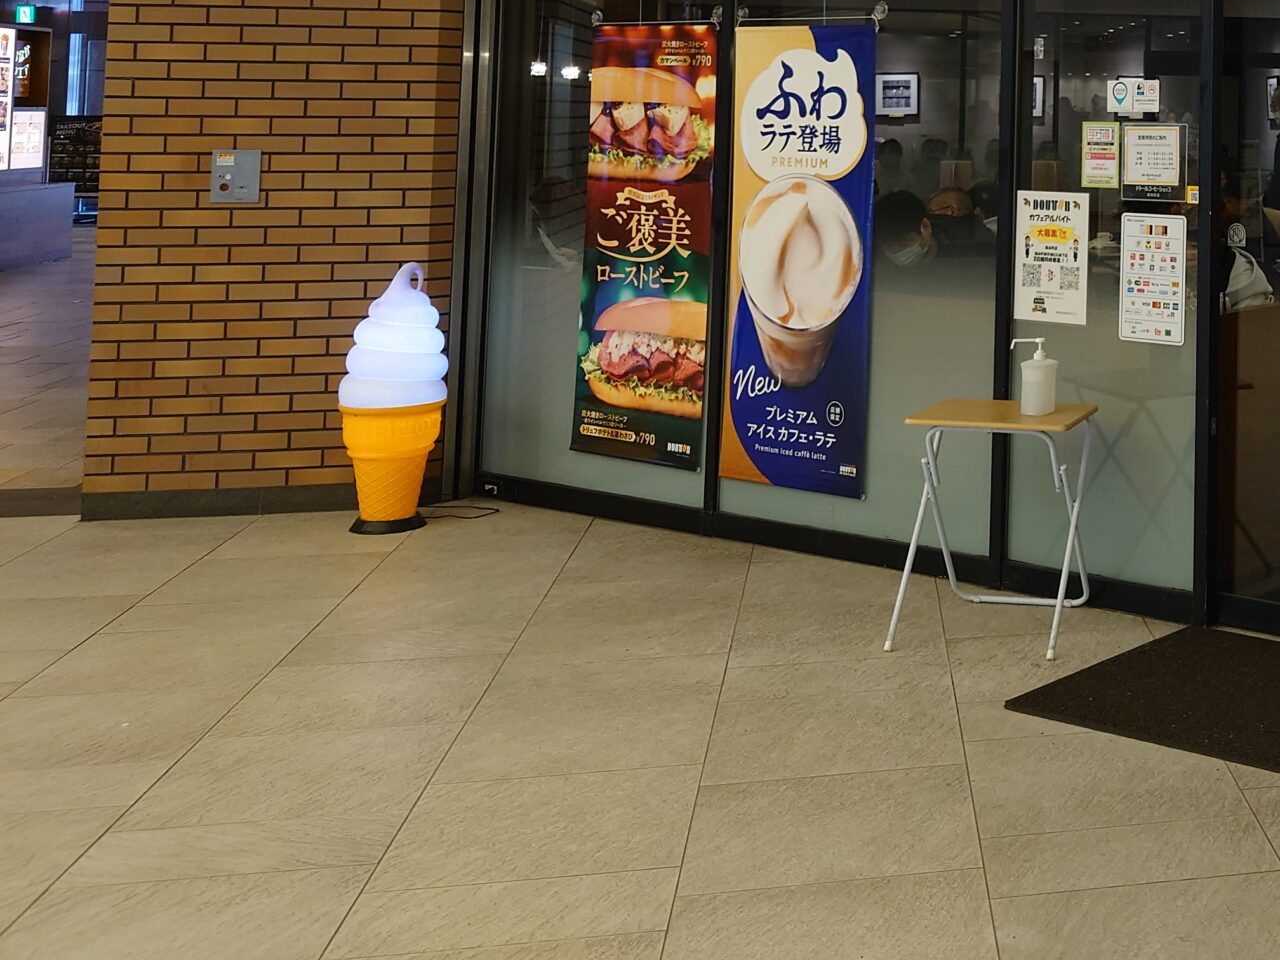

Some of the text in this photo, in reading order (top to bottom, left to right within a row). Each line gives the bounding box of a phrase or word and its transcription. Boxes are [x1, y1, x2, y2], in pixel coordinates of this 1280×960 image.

[692, 55, 712, 66] ¥790
[756, 60, 847, 121] ふわ
[760, 124, 842, 154] ラテ登場
[772, 156, 828, 168] PREMIUM
[1033, 199, 1070, 212] DOUTOR
[1029, 214, 1071, 223] カフェアルバイト
[596, 205, 692, 259] ご褒美
[597, 265, 690, 293] ローストビーフ
[733, 365, 782, 401] New
[765, 405, 818, 425] プレミアム
[636, 433, 656, 446] ¥790
[746, 423, 837, 449] アイス カフェ・ラテ
[755, 443, 779, 454] Premium
[780, 446, 793, 456] iced
[811, 451, 827, 461] latte
